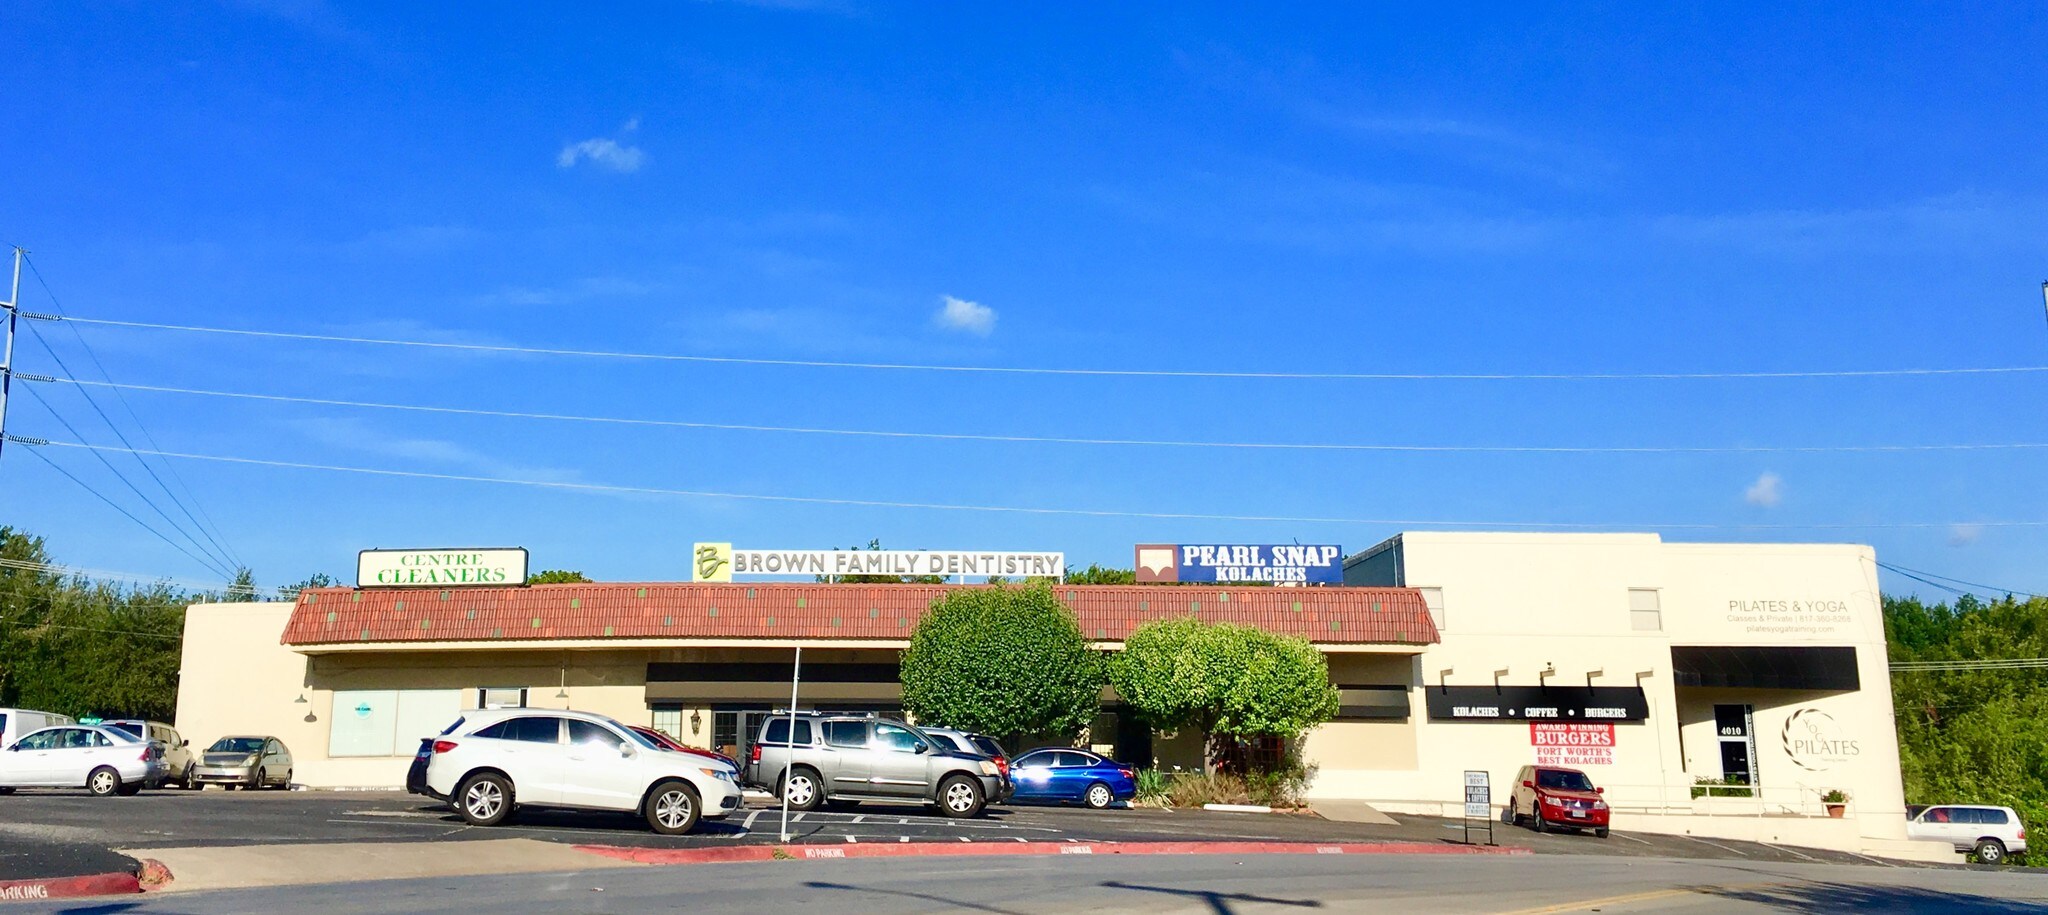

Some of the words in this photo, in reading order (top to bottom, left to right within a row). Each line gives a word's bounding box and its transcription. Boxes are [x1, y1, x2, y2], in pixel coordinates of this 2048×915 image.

[401, 553, 483, 566] CENTRE
[1182, 546, 1266, 567] PEARL
[1272, 546, 1338, 567] SNAP
[735, 553, 825, 572] BROWN
[836, 553, 919, 573] FAMILY
[929, 554, 1059, 574] DENTISTRY
[377, 567, 506, 584] CLEANERS
[1215, 567, 1307, 582] KOLACHES
[1729, 600, 1788, 612] PILATES
[1792, 600, 1801, 612] &
[1805, 601, 1848, 613] YOGA
[1727, 615, 1757, 623] Classes
[1767, 615, 1793, 623] Private
[1746, 625, 1835, 634] pilatesyogatraining.com
[1453, 706, 1500, 717] KOLACHES
[1525, 707, 1558, 718] COFFEE
[1585, 707, 1627, 718] BURGERS
[1536, 723, 1567, 732] AWARD
[1569, 723, 1609, 732] WINNING
[1721, 727, 1742, 735] 4010
[1536, 732, 1611, 746] BURGERS
[1537, 747, 1562, 756] FORT
[1567, 747, 1612, 756] WORTH'S
[1794, 740, 1860, 756] PILATES
[1538, 756, 1560, 765] BEST
[1564, 757, 1613, 765] KOLACHES
